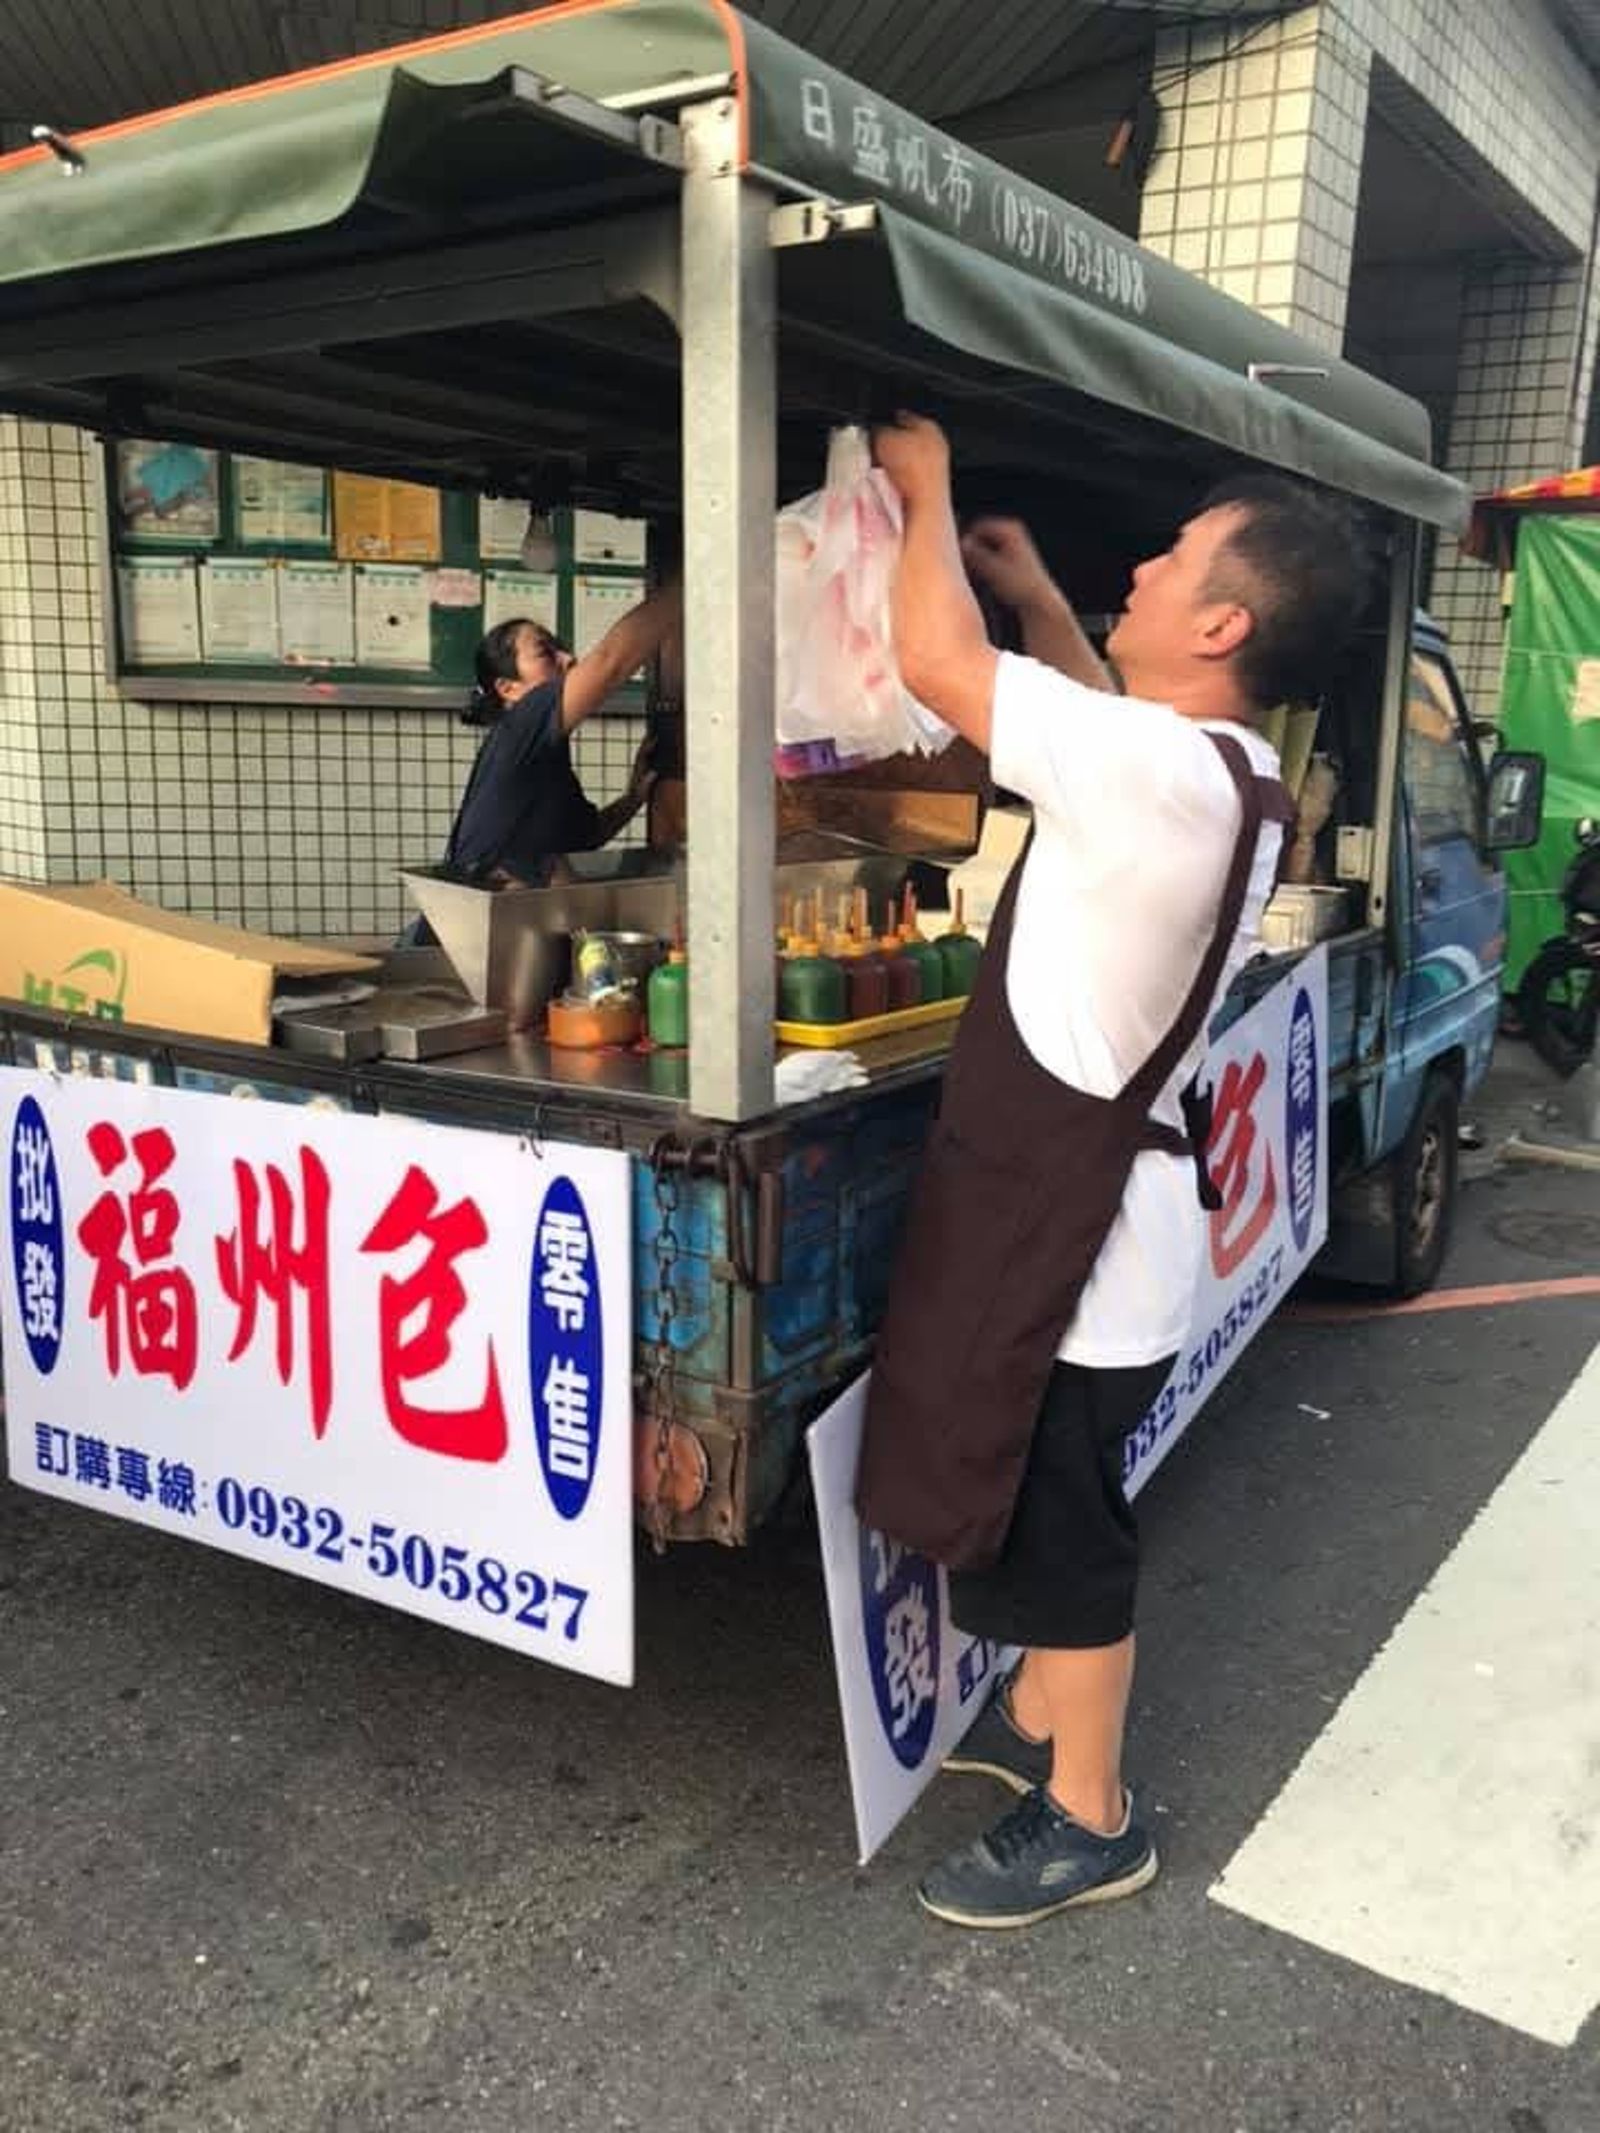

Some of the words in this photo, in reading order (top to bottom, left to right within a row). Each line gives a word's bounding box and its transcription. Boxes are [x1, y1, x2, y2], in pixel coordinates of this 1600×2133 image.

[800, 79, 975, 226] 日盛帆布
[17, 1122, 59, 1343] 批發
[78, 1121, 510, 1464] 福州包
[539, 1209, 591, 1482] 零售
[216, 1478, 590, 1643] 0932-505827
